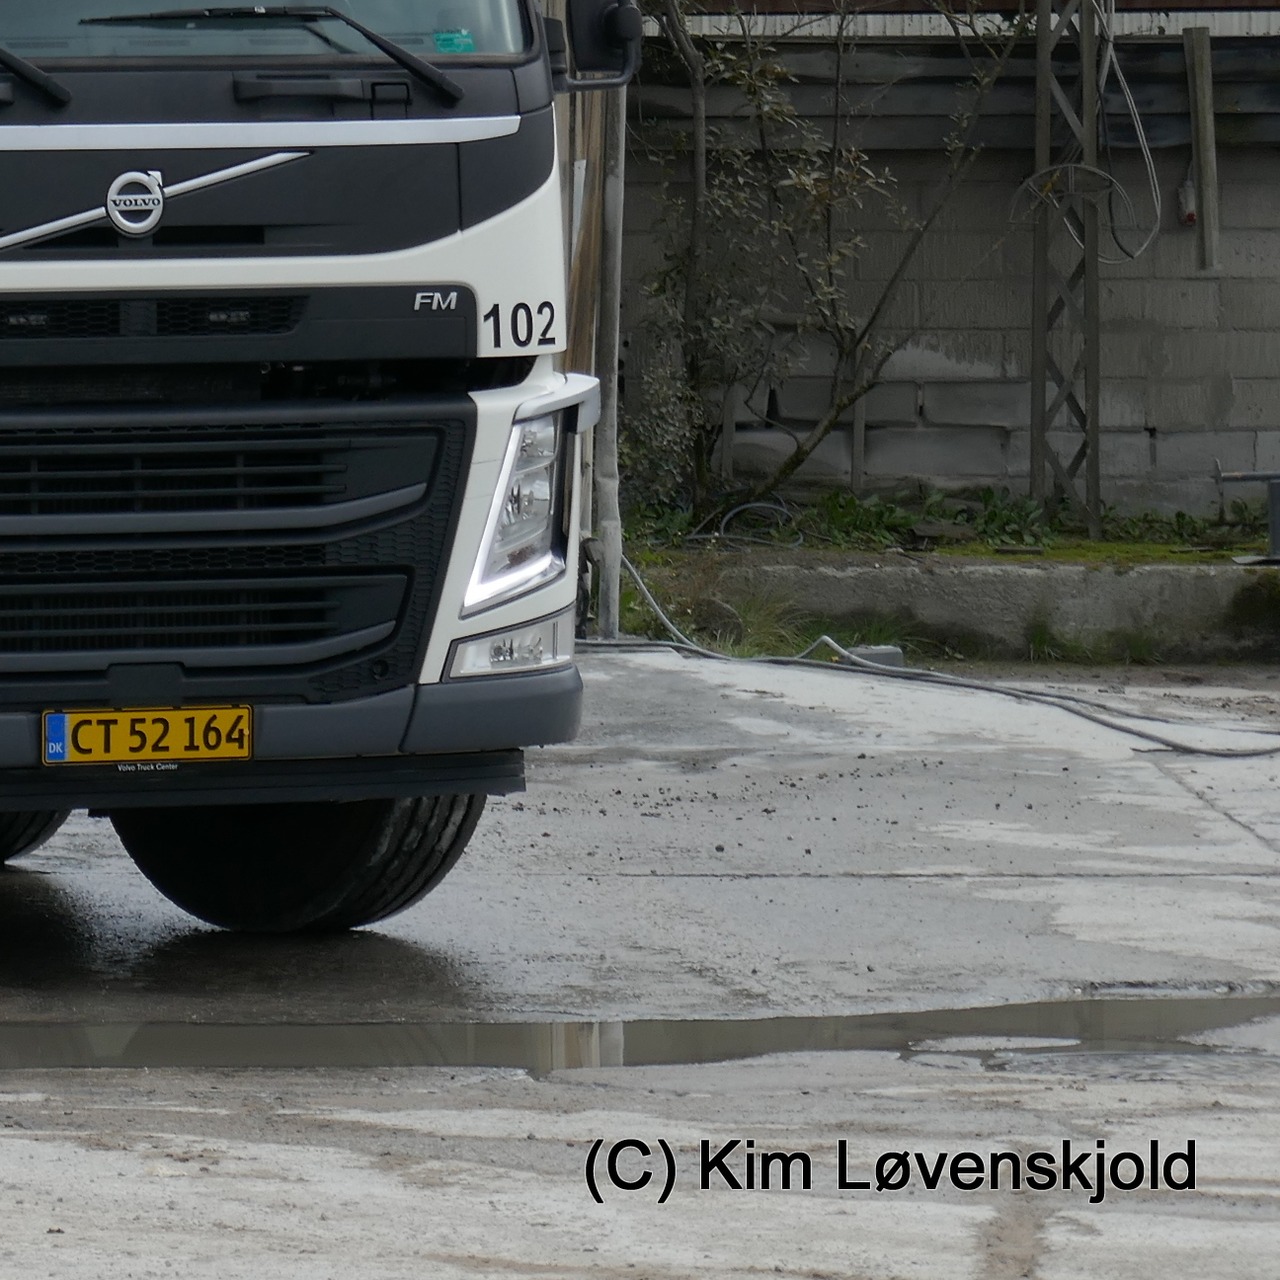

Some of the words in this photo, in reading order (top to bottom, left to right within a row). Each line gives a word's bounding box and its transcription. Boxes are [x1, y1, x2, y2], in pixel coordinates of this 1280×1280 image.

[110, 198, 161, 207] VOLVO
[413, 291, 458, 311] FM
[483, 301, 556, 348] 102
[71, 719, 118, 754] CT
[129, 717, 170, 752] 52
[184, 714, 244, 751] 164
[49, 741, 63, 754] DK
[117, 763, 136, 772] Volvo
[137, 763, 155, 771] Truck
[156, 762, 178, 771] Center
